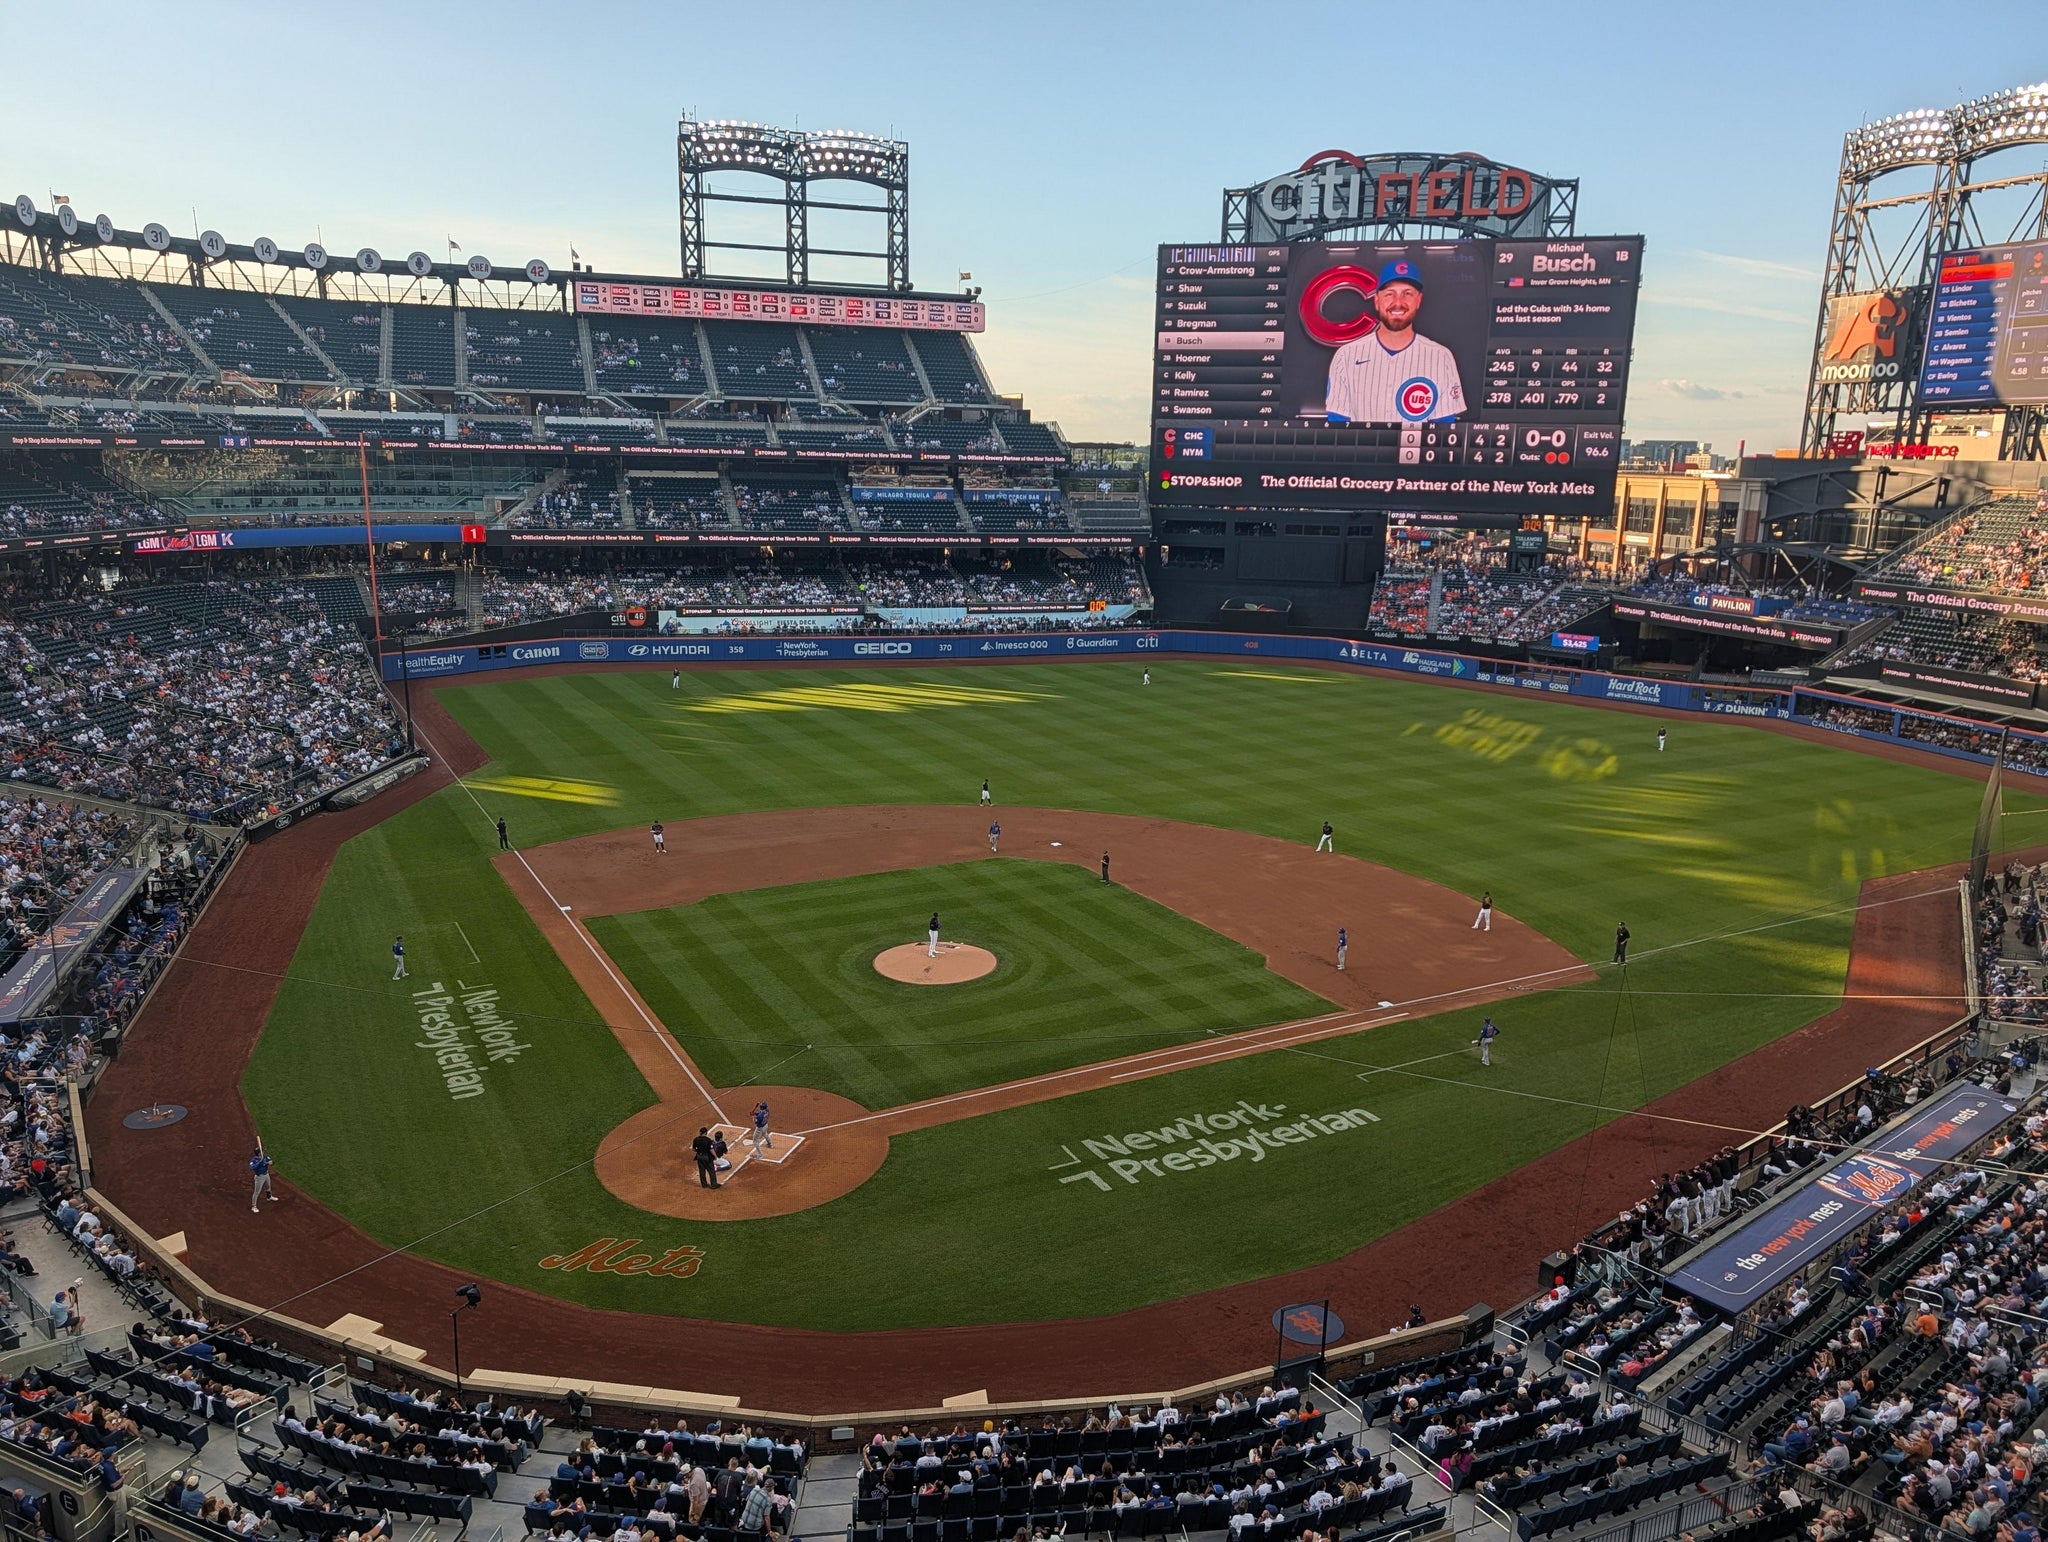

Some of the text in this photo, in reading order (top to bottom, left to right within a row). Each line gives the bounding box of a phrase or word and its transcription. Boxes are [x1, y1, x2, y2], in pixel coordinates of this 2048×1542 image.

[1262, 160, 1533, 222] citi FIELD
[20, 204, 32, 219] 24
[64, 213, 71, 227] 17
[99, 221, 110, 236] 36
[150, 230, 163, 244] 31
[207, 238, 219, 251] 41
[1547, 243, 1585, 253] Michael
[260, 244, 272, 257] 14
[309, 249, 322, 263] 37
[1615, 251, 1629, 261] 1B
[1498, 253, 1514, 263] 29
[1532, 253, 1596, 272] Busch
[471, 262, 489, 273] SHEA
[530, 265, 545, 277] 42
[1179, 266, 1255, 277] Crow-Armstrong
[1530, 278, 1547, 286] Inver
[1548, 278, 1568, 286] Grove
[1570, 277, 1598, 287] Heights,
[1178, 284, 1202, 293] Shaw
[1178, 301, 1207, 310] Suzuki
[1496, 304, 1611, 313] Led the Cubs with 34 home
[1177, 319, 1217, 329] Bregman
[1496, 314, 1561, 323] runs last season
[1176, 336, 1203, 345] Busch
[1942, 343, 1967, 351] Alvarez
[1175, 354, 1211, 363] Hoerner
[1940, 357, 1973, 366] Wagaman
[1488, 361, 1515, 373] .245
[1531, 362, 1540, 373] 9
[1562, 362, 1578, 373] 44
[1597, 362, 1613, 373] 32
[1822, 362, 1899, 380] moomoo
[2011, 367, 2028, 375] 4.58
[1174, 371, 1196, 382] Kelly
[1937, 372, 1958, 381] Ewing
[1935, 387, 1950, 395] Baty
[1486, 392, 1512, 403] .378
[1520, 393, 1545, 404] .401
[1554, 393, 1579, 404] .779
[1596, 393, 1605, 404] 2
[1173, 405, 1212, 415] Swanson
[1184, 432, 1204, 440] CHC
[1406, 434, 1415, 444] 0
[1427, 434, 1436, 444] 0
[1447, 434, 1457, 445] 0
[1475, 435, 1484, 445] 4
[1496, 435, 1506, 445] 2
[1584, 431, 1614, 440] Exit Vel.
[1182, 448, 1204, 457] NYM
[1405, 451, 1414, 461] 0
[1425, 451, 1435, 461] 0
[1448, 451, 1454, 461] 1
[1474, 451, 1483, 462] 4
[1495, 452, 1504, 462] 2
[1520, 453, 1540, 461] Outs:
[1585, 448, 1609, 457] 96.6
[1261, 475, 1595, 495] The Official Grocery Partner of the New York Mets
[877, 491, 930, 500] MILAGRO TEQUILA
[195, 533, 217, 547] LGM
[1693, 596, 1751, 613] citi PAVILION
[1907, 591, 2011, 614] The Official Grocery
[634, 612, 644, 620] 46
[1618, 606, 1786, 638] STOP&SHOP The Official Grocery Partner of the New York Mets
[1076, 638, 1118, 648] Guardian
[1136, 636, 1159, 648] citi
[1562, 639, 1587, 648] $3,425
[1795, 632, 1832, 645] STOP&SHOP
[652, 645, 710, 655] HYUNDAI
[729, 645, 744, 654] 358
[783, 641, 819, 650] NewYork-
[853, 642, 912, 654] GEICO
[939, 643, 952, 651] 370
[995, 639, 1048, 650] Invesco QQQ
[512, 646, 561, 661] Canon
[783, 648, 829, 657] Presbyterian
[1351, 648, 1387, 662] DELTA
[1418, 658, 1451, 669] HAUGLAND
[1418, 664, 1439, 673] GROUP
[1476, 672, 1490, 681] 380
[1496, 675, 1515, 684] GOYA
[1522, 678, 1542, 688] GOYA
[1549, 682, 1569, 692] GOYA
[1608, 678, 1661, 697] Hard Rock
[1726, 702, 1769, 716] DUNKIN'
[1776, 708, 1790, 719] 370
[1811, 719, 1860, 736] CADILLAC
[304, 801, 321, 815] DELTA
[459, 989, 533, 1064] NewYork-
[414, 995, 489, 1100] Presbyterian
[1081, 1100, 1288, 1160] NewYork-
[1894, 1106, 1979, 1162] the new york mets
[1107, 1107, 1382, 1184] Presbyterian
[1846, 1164, 1905, 1201] Mets
[1735, 1252, 1768, 1272] the
[1760, 1236, 1791, 1257] new
[1786, 1218, 1818, 1244] york
[1808, 1198, 1844, 1224] mets
[538, 1237, 707, 1279] Mets
